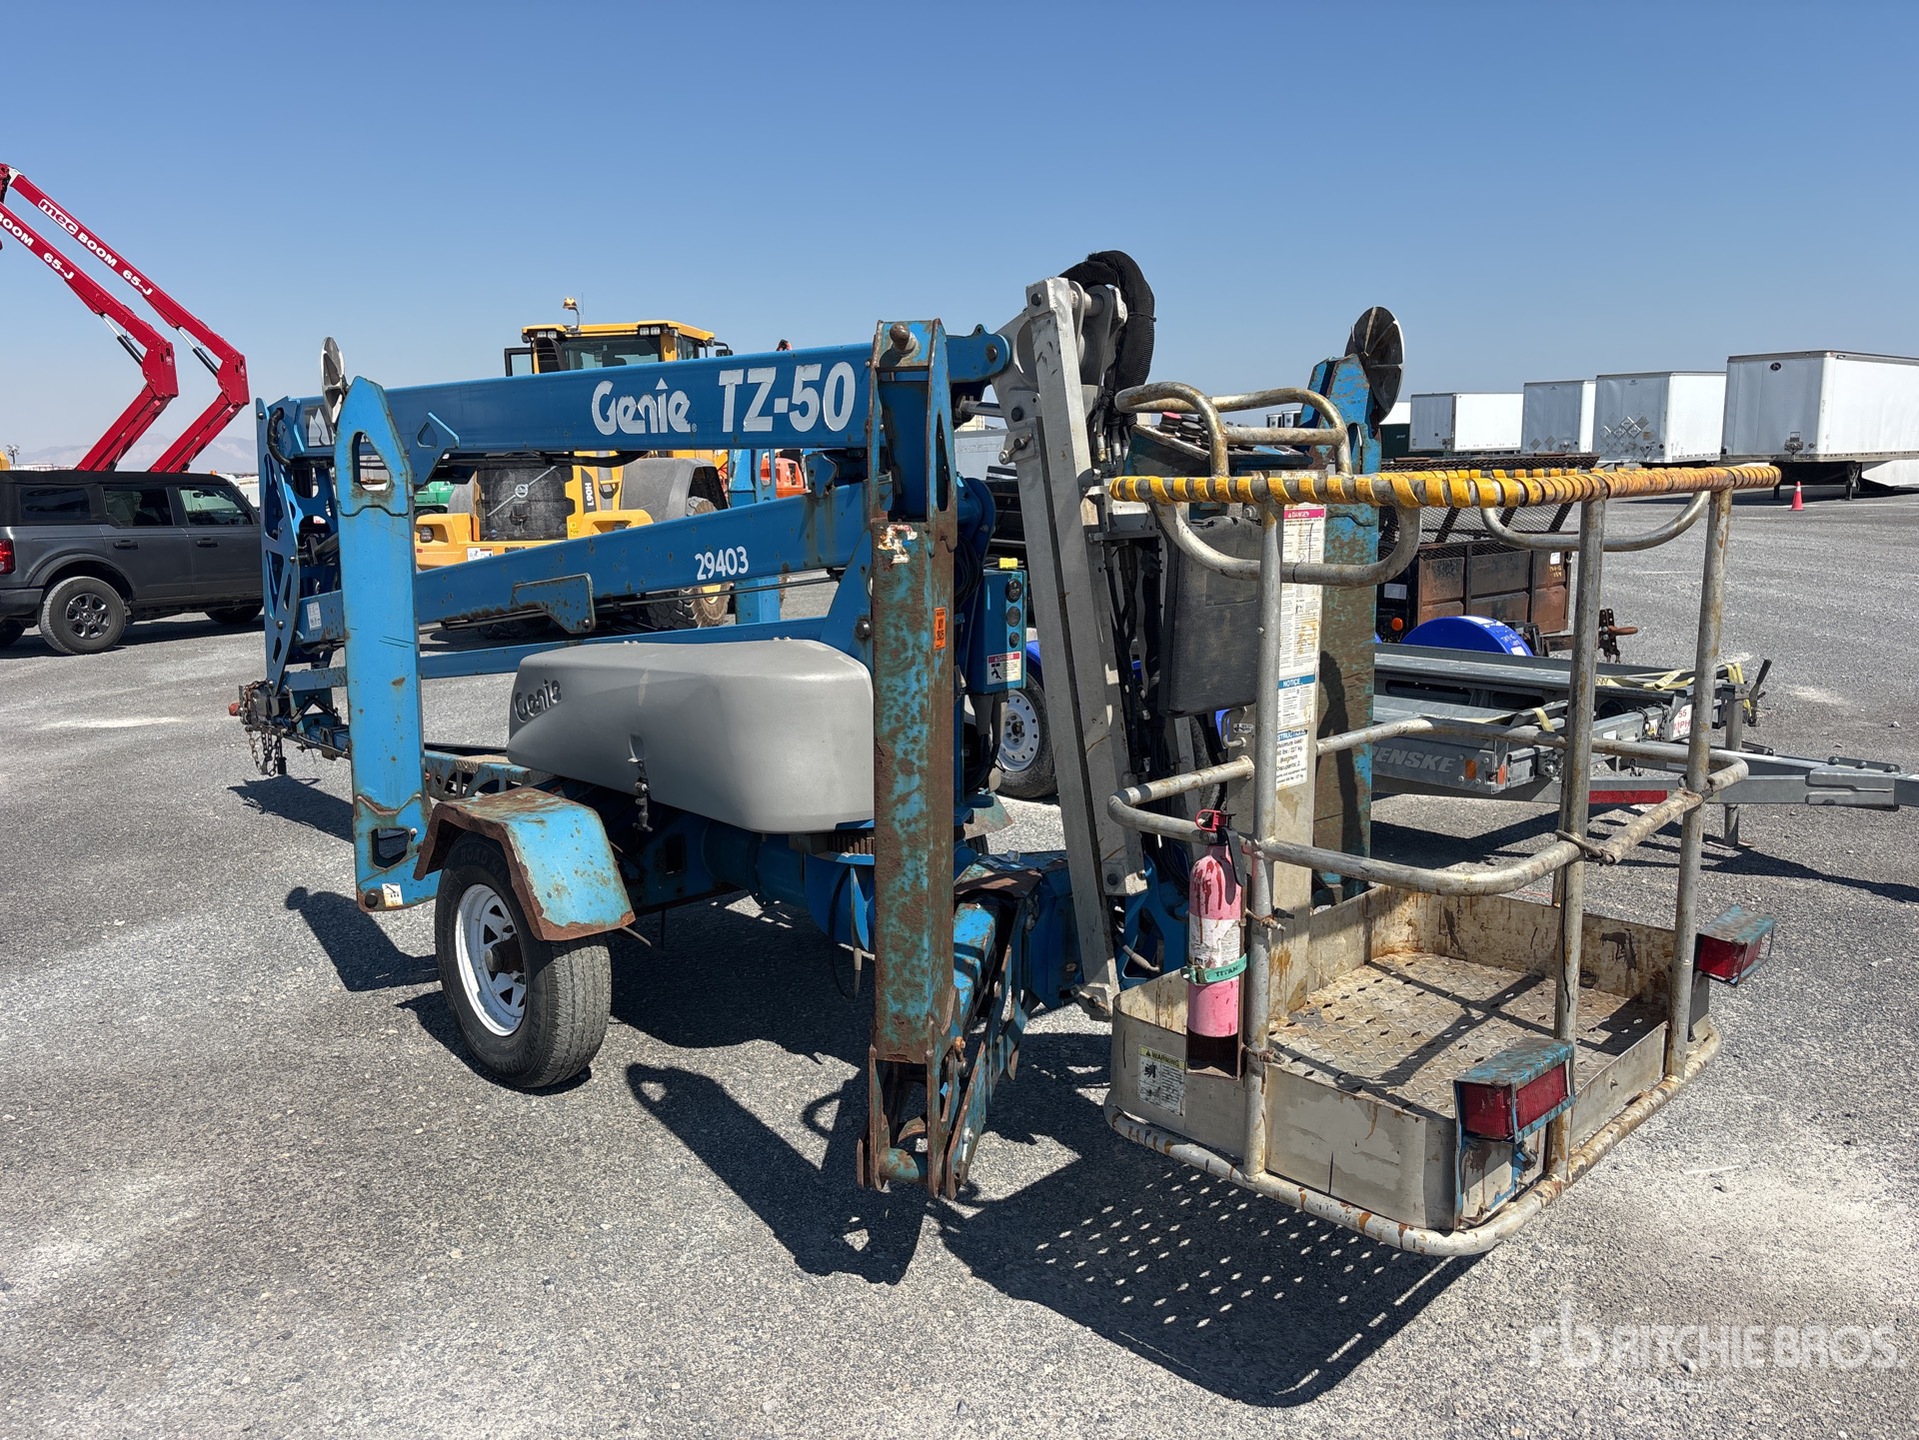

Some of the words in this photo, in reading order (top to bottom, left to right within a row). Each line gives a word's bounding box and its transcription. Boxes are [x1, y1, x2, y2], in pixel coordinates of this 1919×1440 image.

[39, 200, 78, 233] mec
[77, 232, 118, 267] BOOM
[122, 269, 153, 295] 65-J
[43, 252, 75, 280] 65-J
[591, 377, 692, 436] Genie
[718, 361, 857, 433] TZ-50
[584, 482, 595, 507] L90H
[694, 546, 749, 581] 29403
[1282, 677, 1301, 687] NOTICE
[515, 679, 562, 723] Genie
[1215, 965, 1238, 977] TITAN
[1151, 1050, 1180, 1068] WARNING
